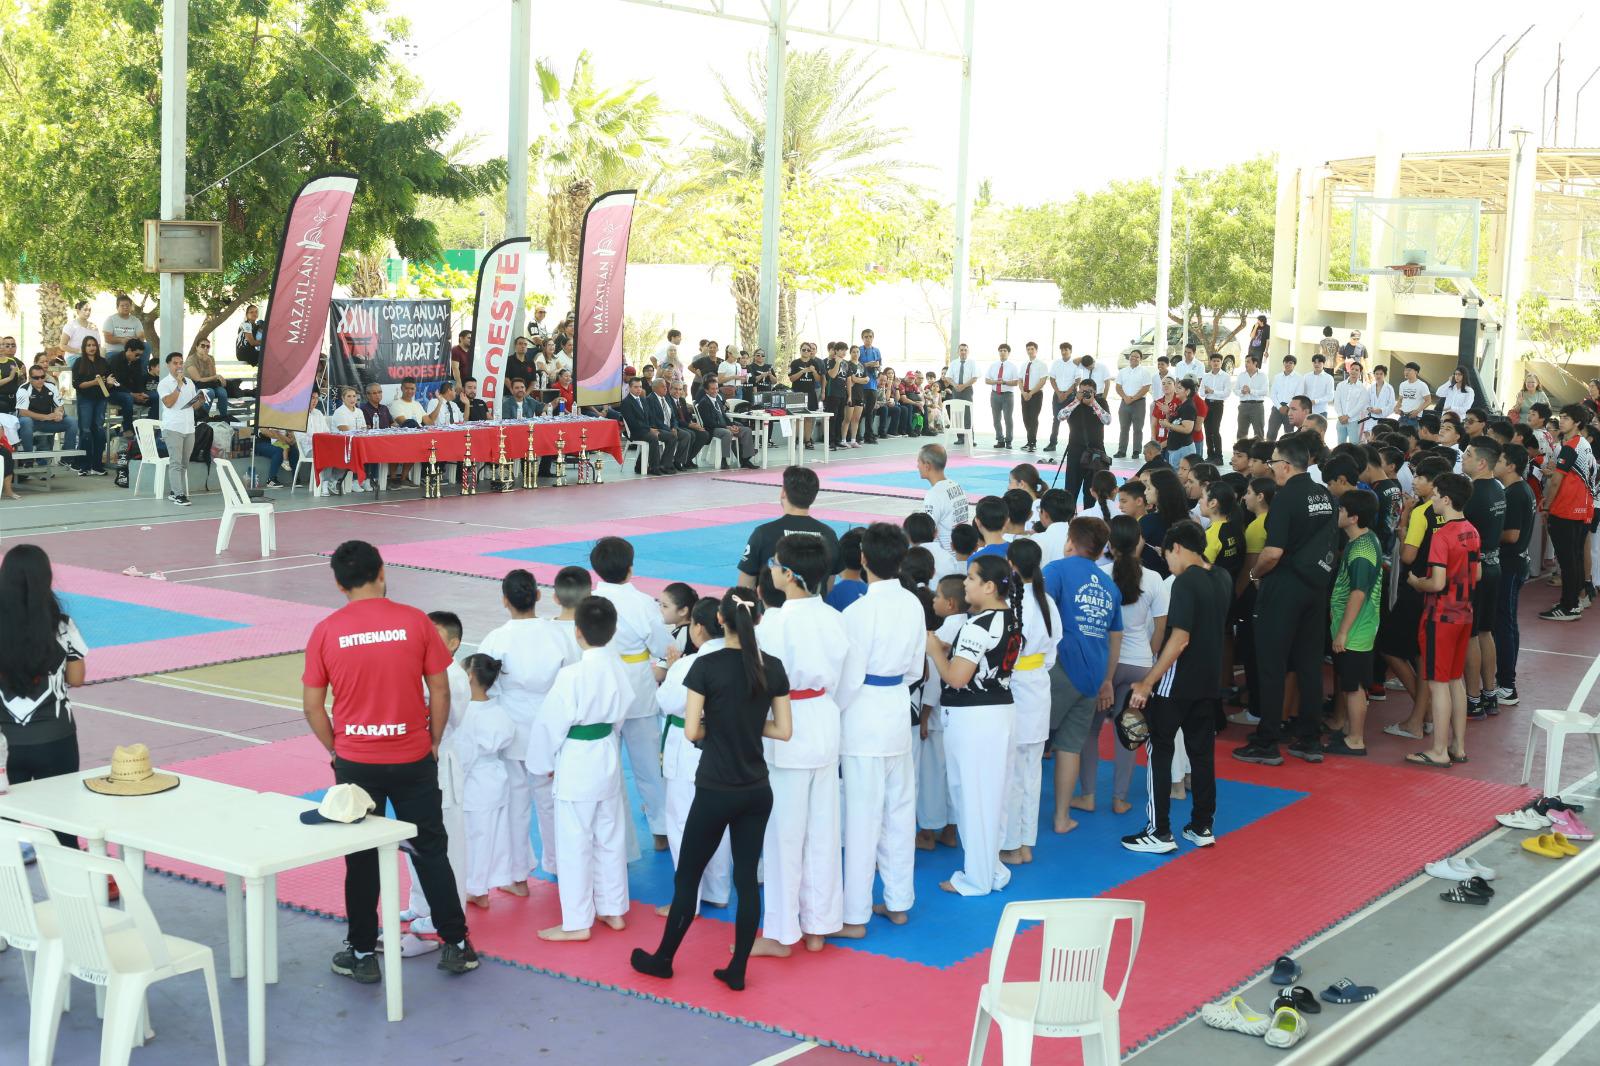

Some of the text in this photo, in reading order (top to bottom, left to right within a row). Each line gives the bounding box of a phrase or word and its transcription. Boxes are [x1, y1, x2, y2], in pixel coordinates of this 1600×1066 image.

[382, 304, 450, 321] COPA ANUAL
[390, 322, 445, 340] REGIONAL
[395, 341, 441, 361] KARATE
[387, 363, 447, 379] NOROESTE
[1074, 594, 1105, 608] KARATE
[339, 629, 407, 648] ENTRENADOR
[345, 723, 407, 736] KARATE
